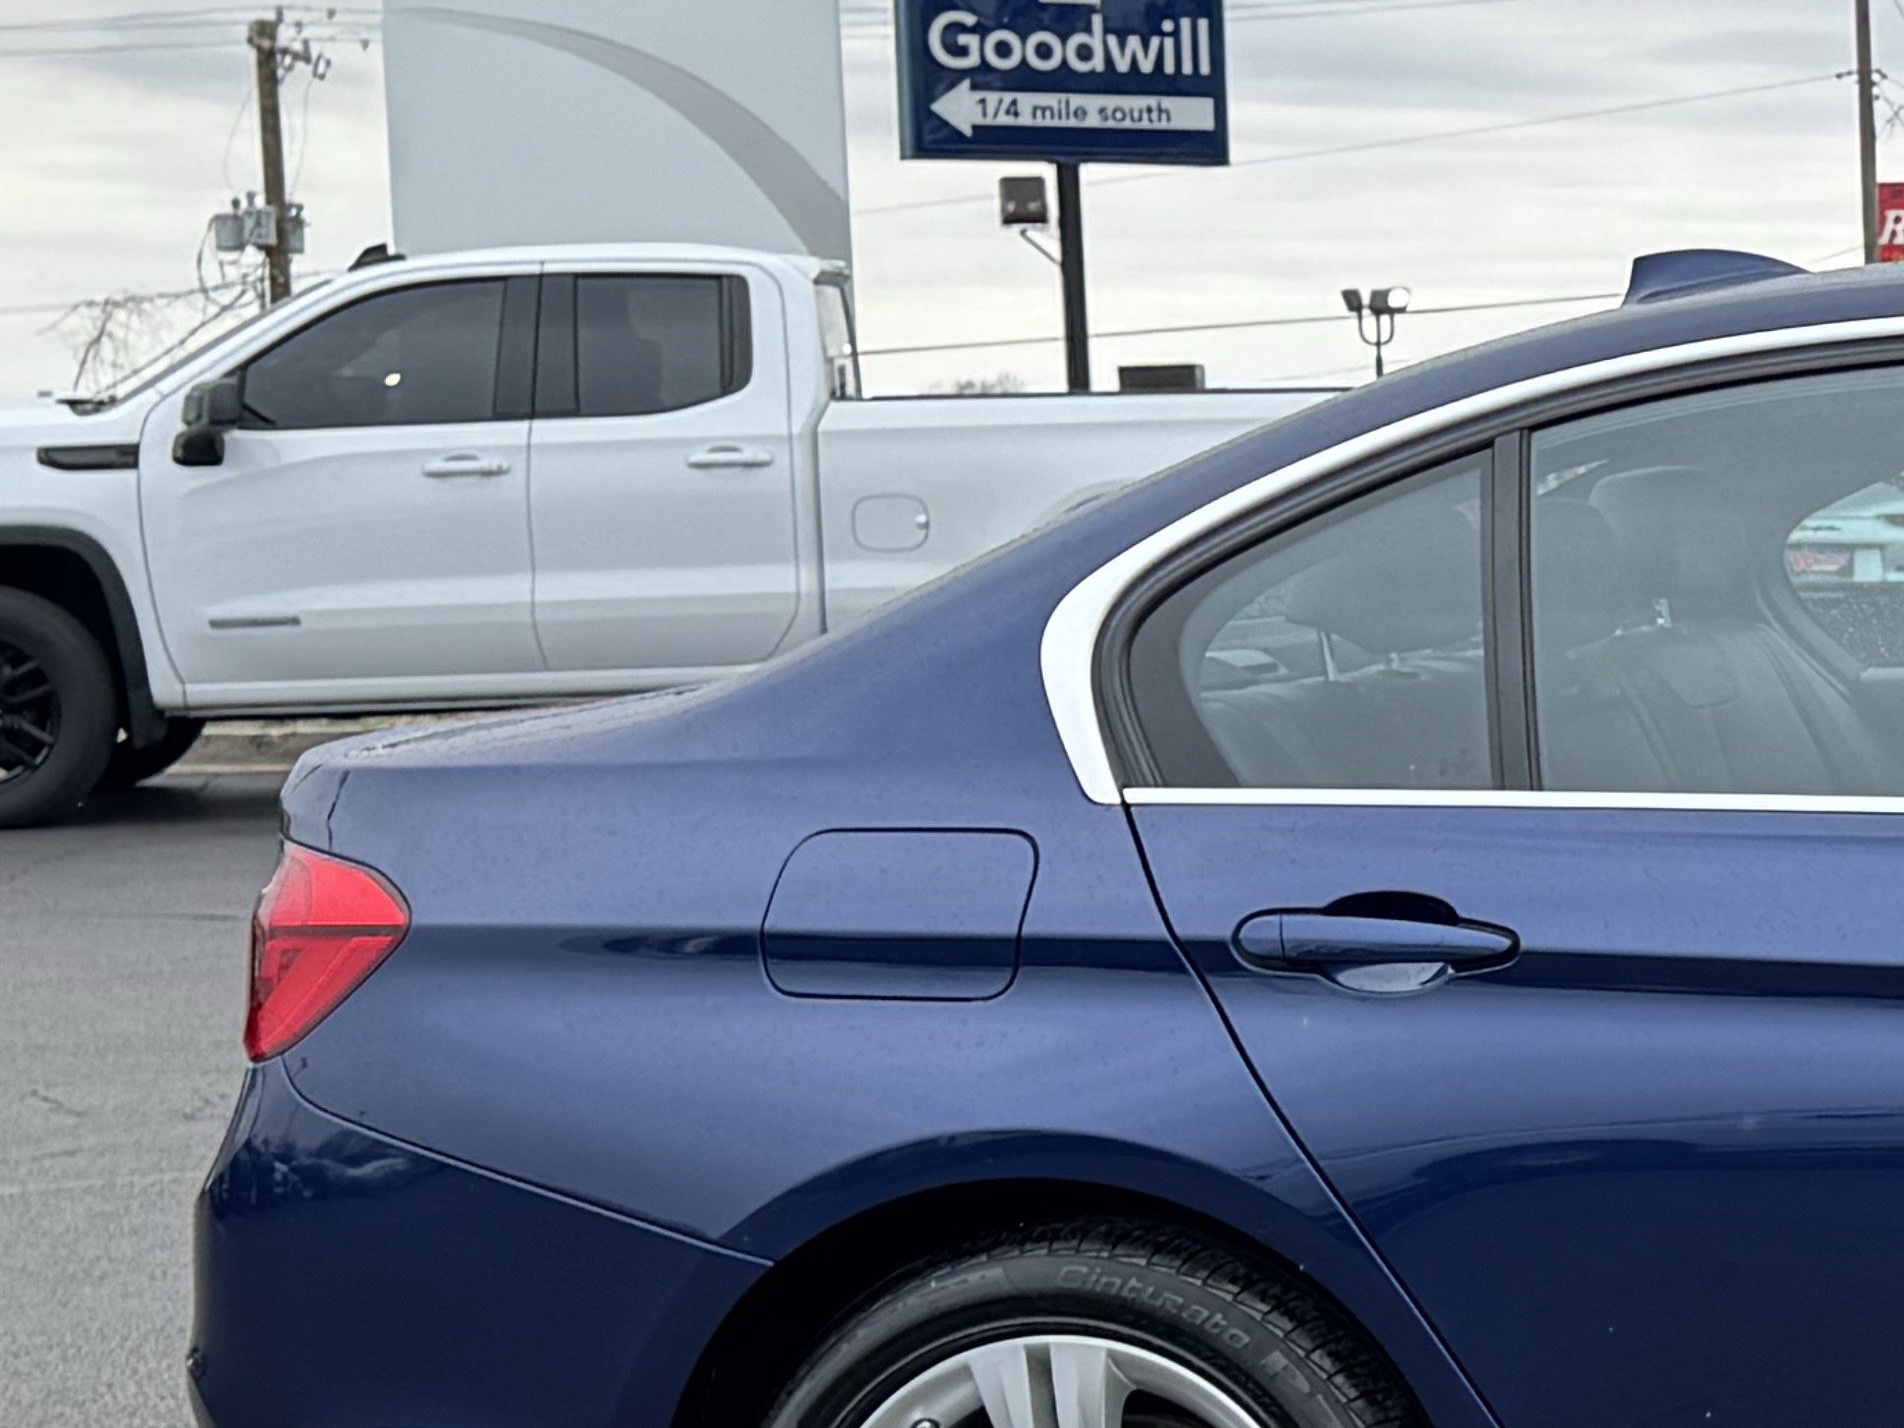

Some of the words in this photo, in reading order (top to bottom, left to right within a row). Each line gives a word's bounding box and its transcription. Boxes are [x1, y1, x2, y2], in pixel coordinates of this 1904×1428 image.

[927, 10, 1211, 76] Goodwill
[975, 97, 1020, 120] 1/4
[1031, 99, 1088, 121] mile
[1097, 100, 1171, 124] south
[1057, 1262, 1252, 1350] Cinturato
